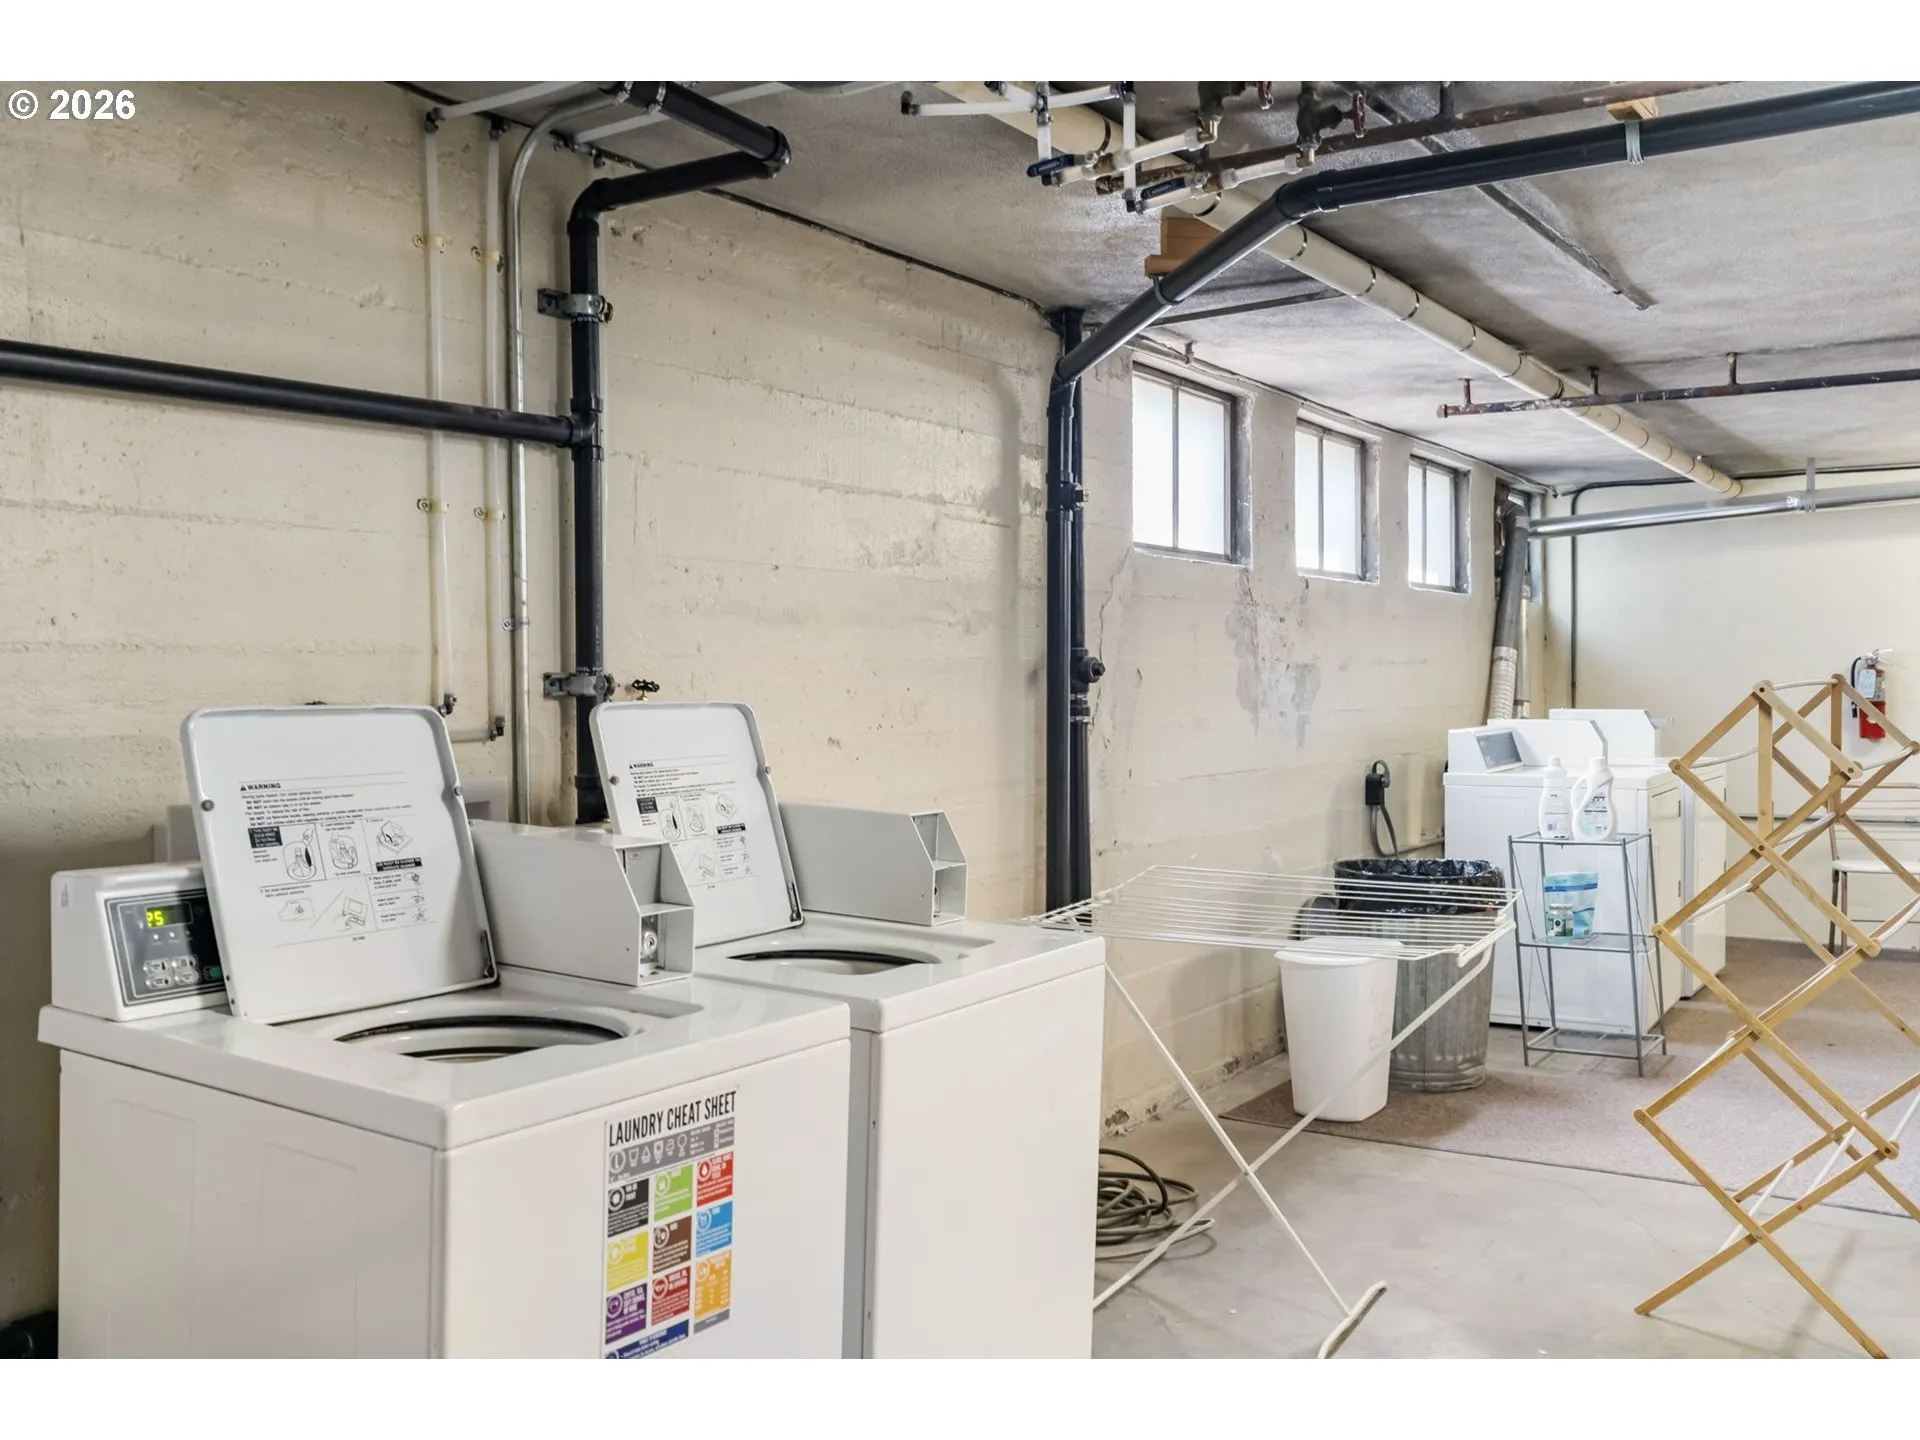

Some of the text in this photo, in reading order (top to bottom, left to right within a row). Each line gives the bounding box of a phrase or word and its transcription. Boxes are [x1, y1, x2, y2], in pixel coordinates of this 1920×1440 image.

[246, 782, 282, 791] WARNING
[609, 1110, 664, 1147] LAUNDRY
[666, 1100, 702, 1131] CHEAT
[704, 1090, 736, 1120] SHEET
